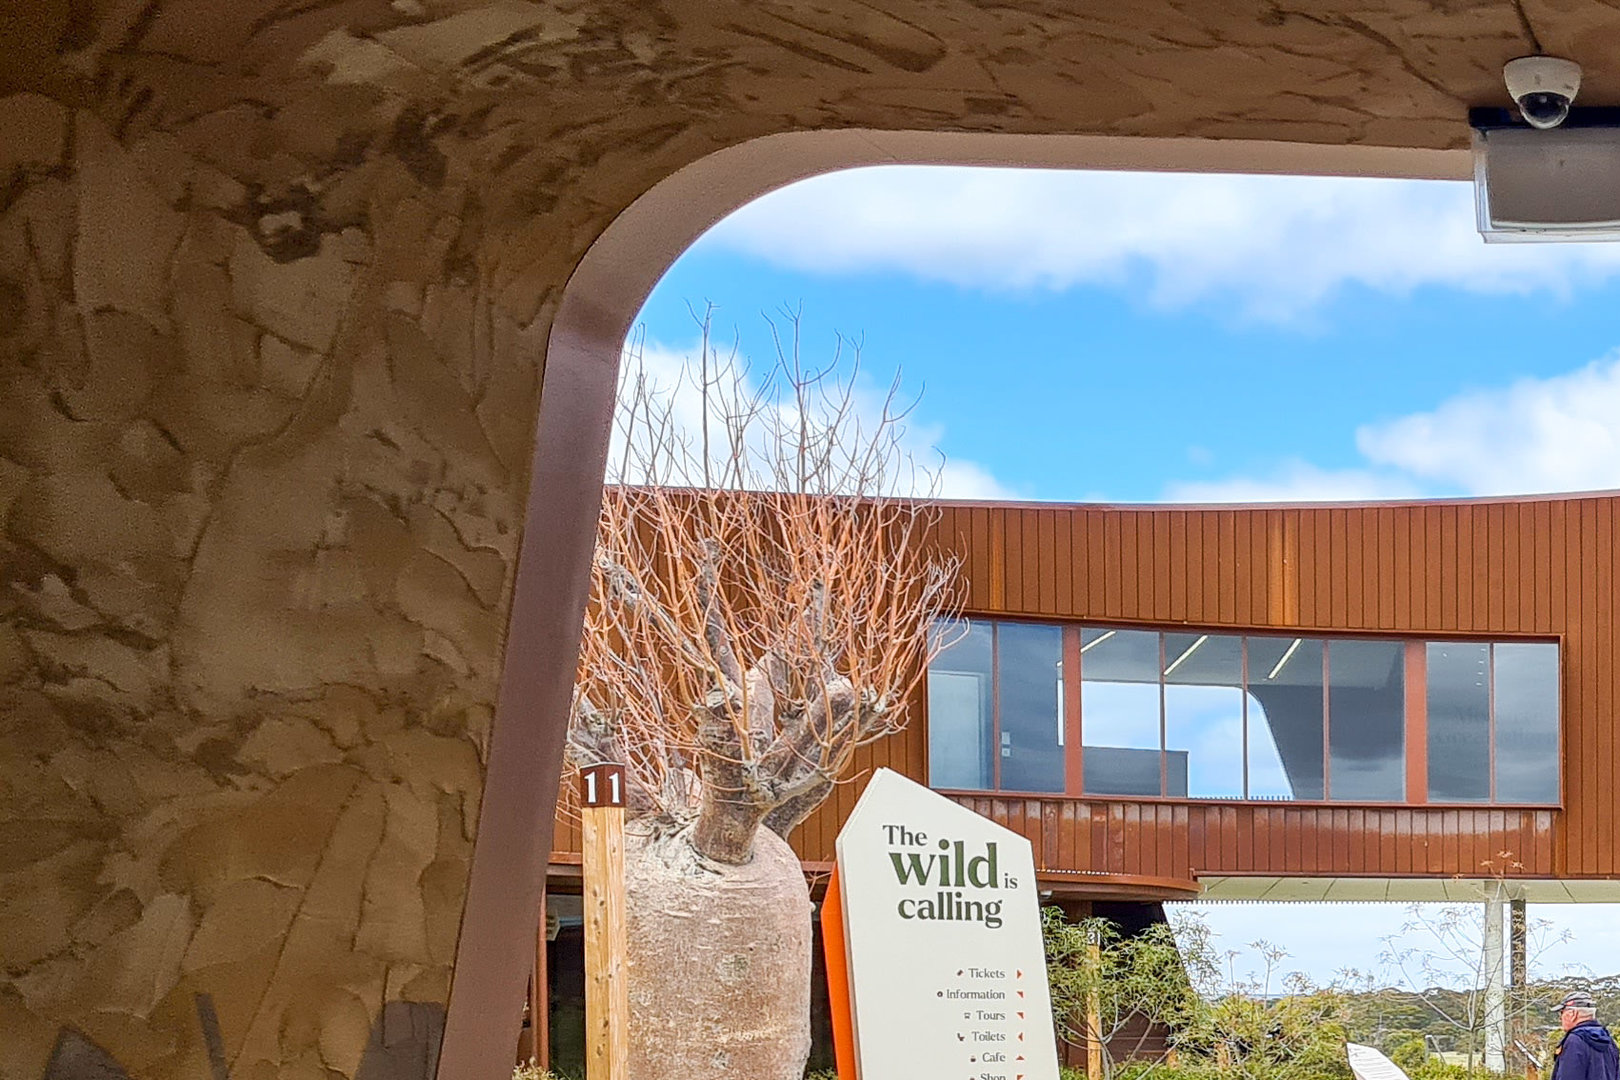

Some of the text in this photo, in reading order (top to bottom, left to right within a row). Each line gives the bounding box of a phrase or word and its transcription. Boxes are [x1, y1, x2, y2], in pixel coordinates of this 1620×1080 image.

[882, 825, 928, 846] The
[889, 839, 1018, 889] wild is
[898, 892, 1003, 929] calling
[968, 968, 1006, 979] Tickets
[946, 989, 1006, 1000] Information
[976, 1011, 1006, 1021] Tours
[971, 1032, 1006, 1042] Toilets
[982, 1053, 1006, 1063] Cafe
